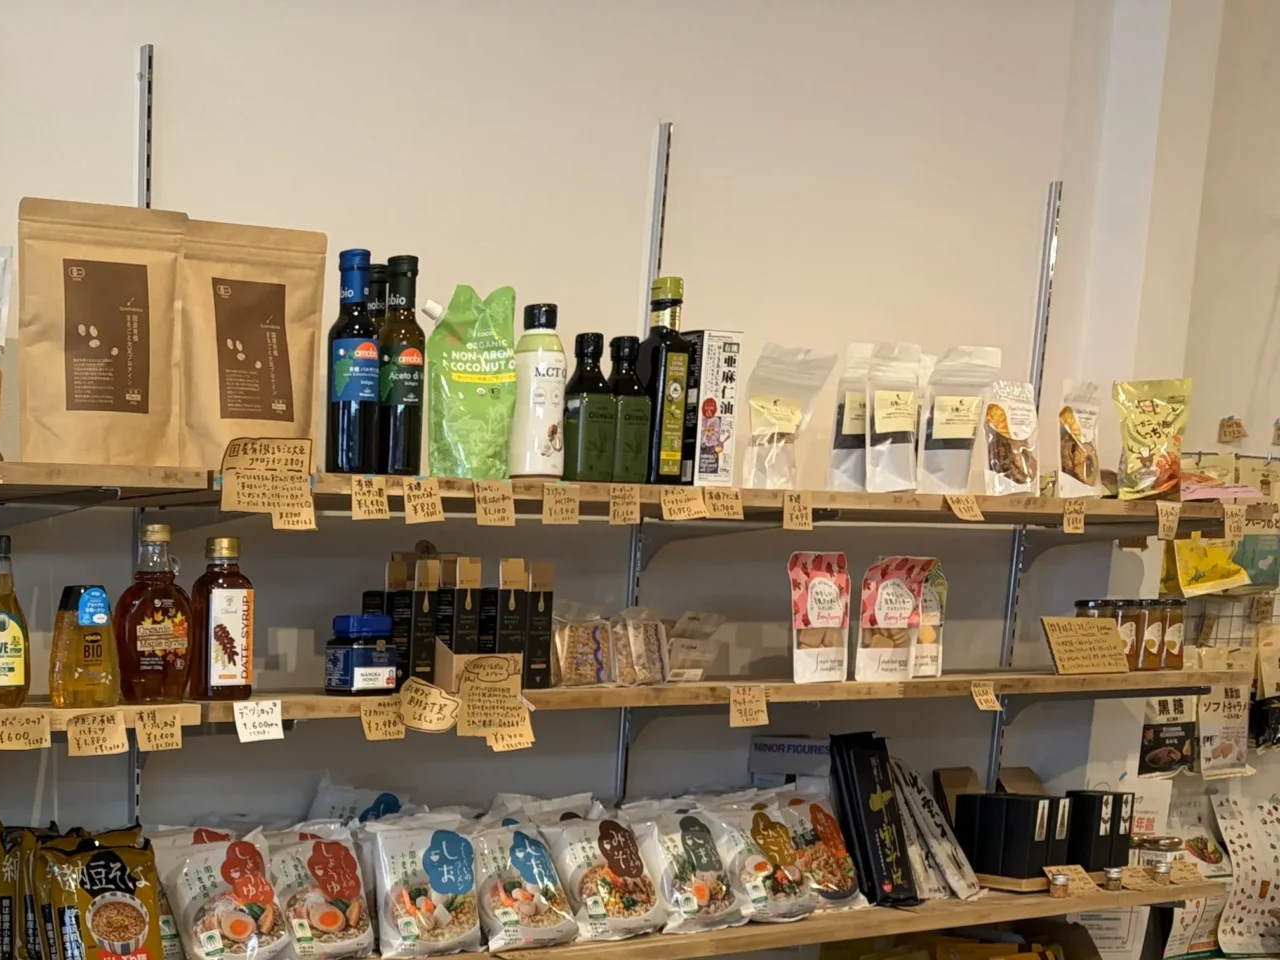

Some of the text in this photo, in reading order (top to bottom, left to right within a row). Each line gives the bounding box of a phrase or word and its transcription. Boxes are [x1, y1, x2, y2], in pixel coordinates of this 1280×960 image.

[450, 360, 505, 372] COCONUT
[534, 367, 559, 377] MCT
[389, 372, 410, 381] Aceto
[720, 354, 737, 416] 亜麻仁油
[284, 458, 305, 468] 280g
[412, 502, 436, 515] ¥820
[138, 625, 171, 635] Organic
[139, 639, 162, 650] Maple
[240, 595, 252, 680] DATE SYRUP
[83, 643, 103, 658] BIO
[1158, 698, 1184, 716] 黒糖
[754, 741, 831, 755] MINOR FIGURES
[321, 843, 341, 894] しょうゆ
[438, 840, 459, 884] しお
[61, 861, 151, 891] 納豆そば
[235, 846, 257, 898] しょうゆ
